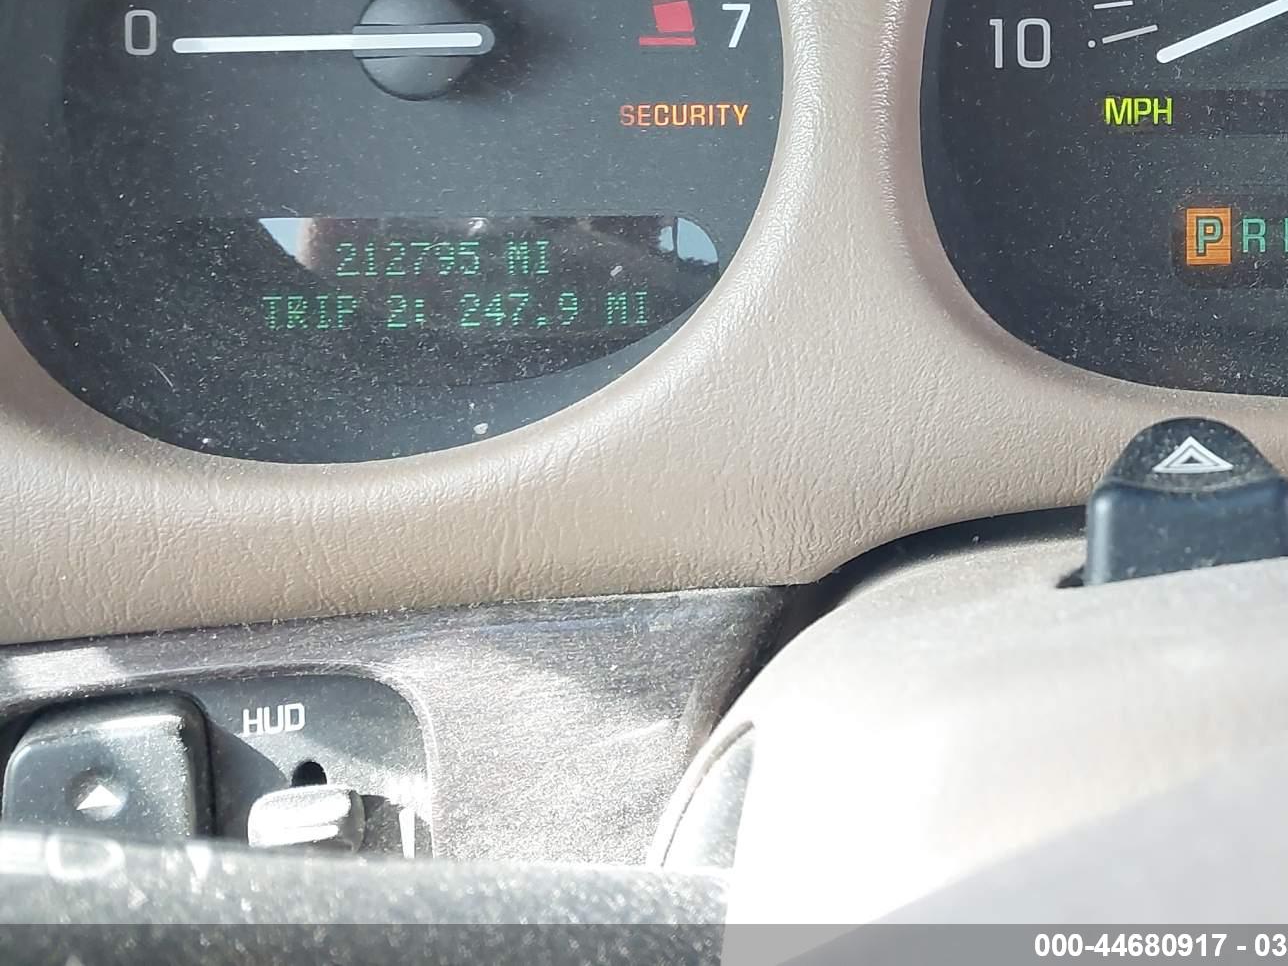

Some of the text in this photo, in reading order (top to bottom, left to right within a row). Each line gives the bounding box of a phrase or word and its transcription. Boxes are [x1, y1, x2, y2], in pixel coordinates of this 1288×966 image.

[125, 9, 156, 56] 0
[721, 3, 751, 49] 7
[988, 18, 1051, 69] 10
[618, 103, 749, 127] SECURITY
[1103, 97, 1174, 127] MPH
[1195, 216, 1224, 255] P
[1242, 218, 1266, 252] R
[335, 241, 550, 276] 212795 MI
[262, 295, 358, 329] TRIP
[459, 293, 579, 327] 247.9
[606, 291, 649, 324] MI
[243, 702, 305, 734] HUD
